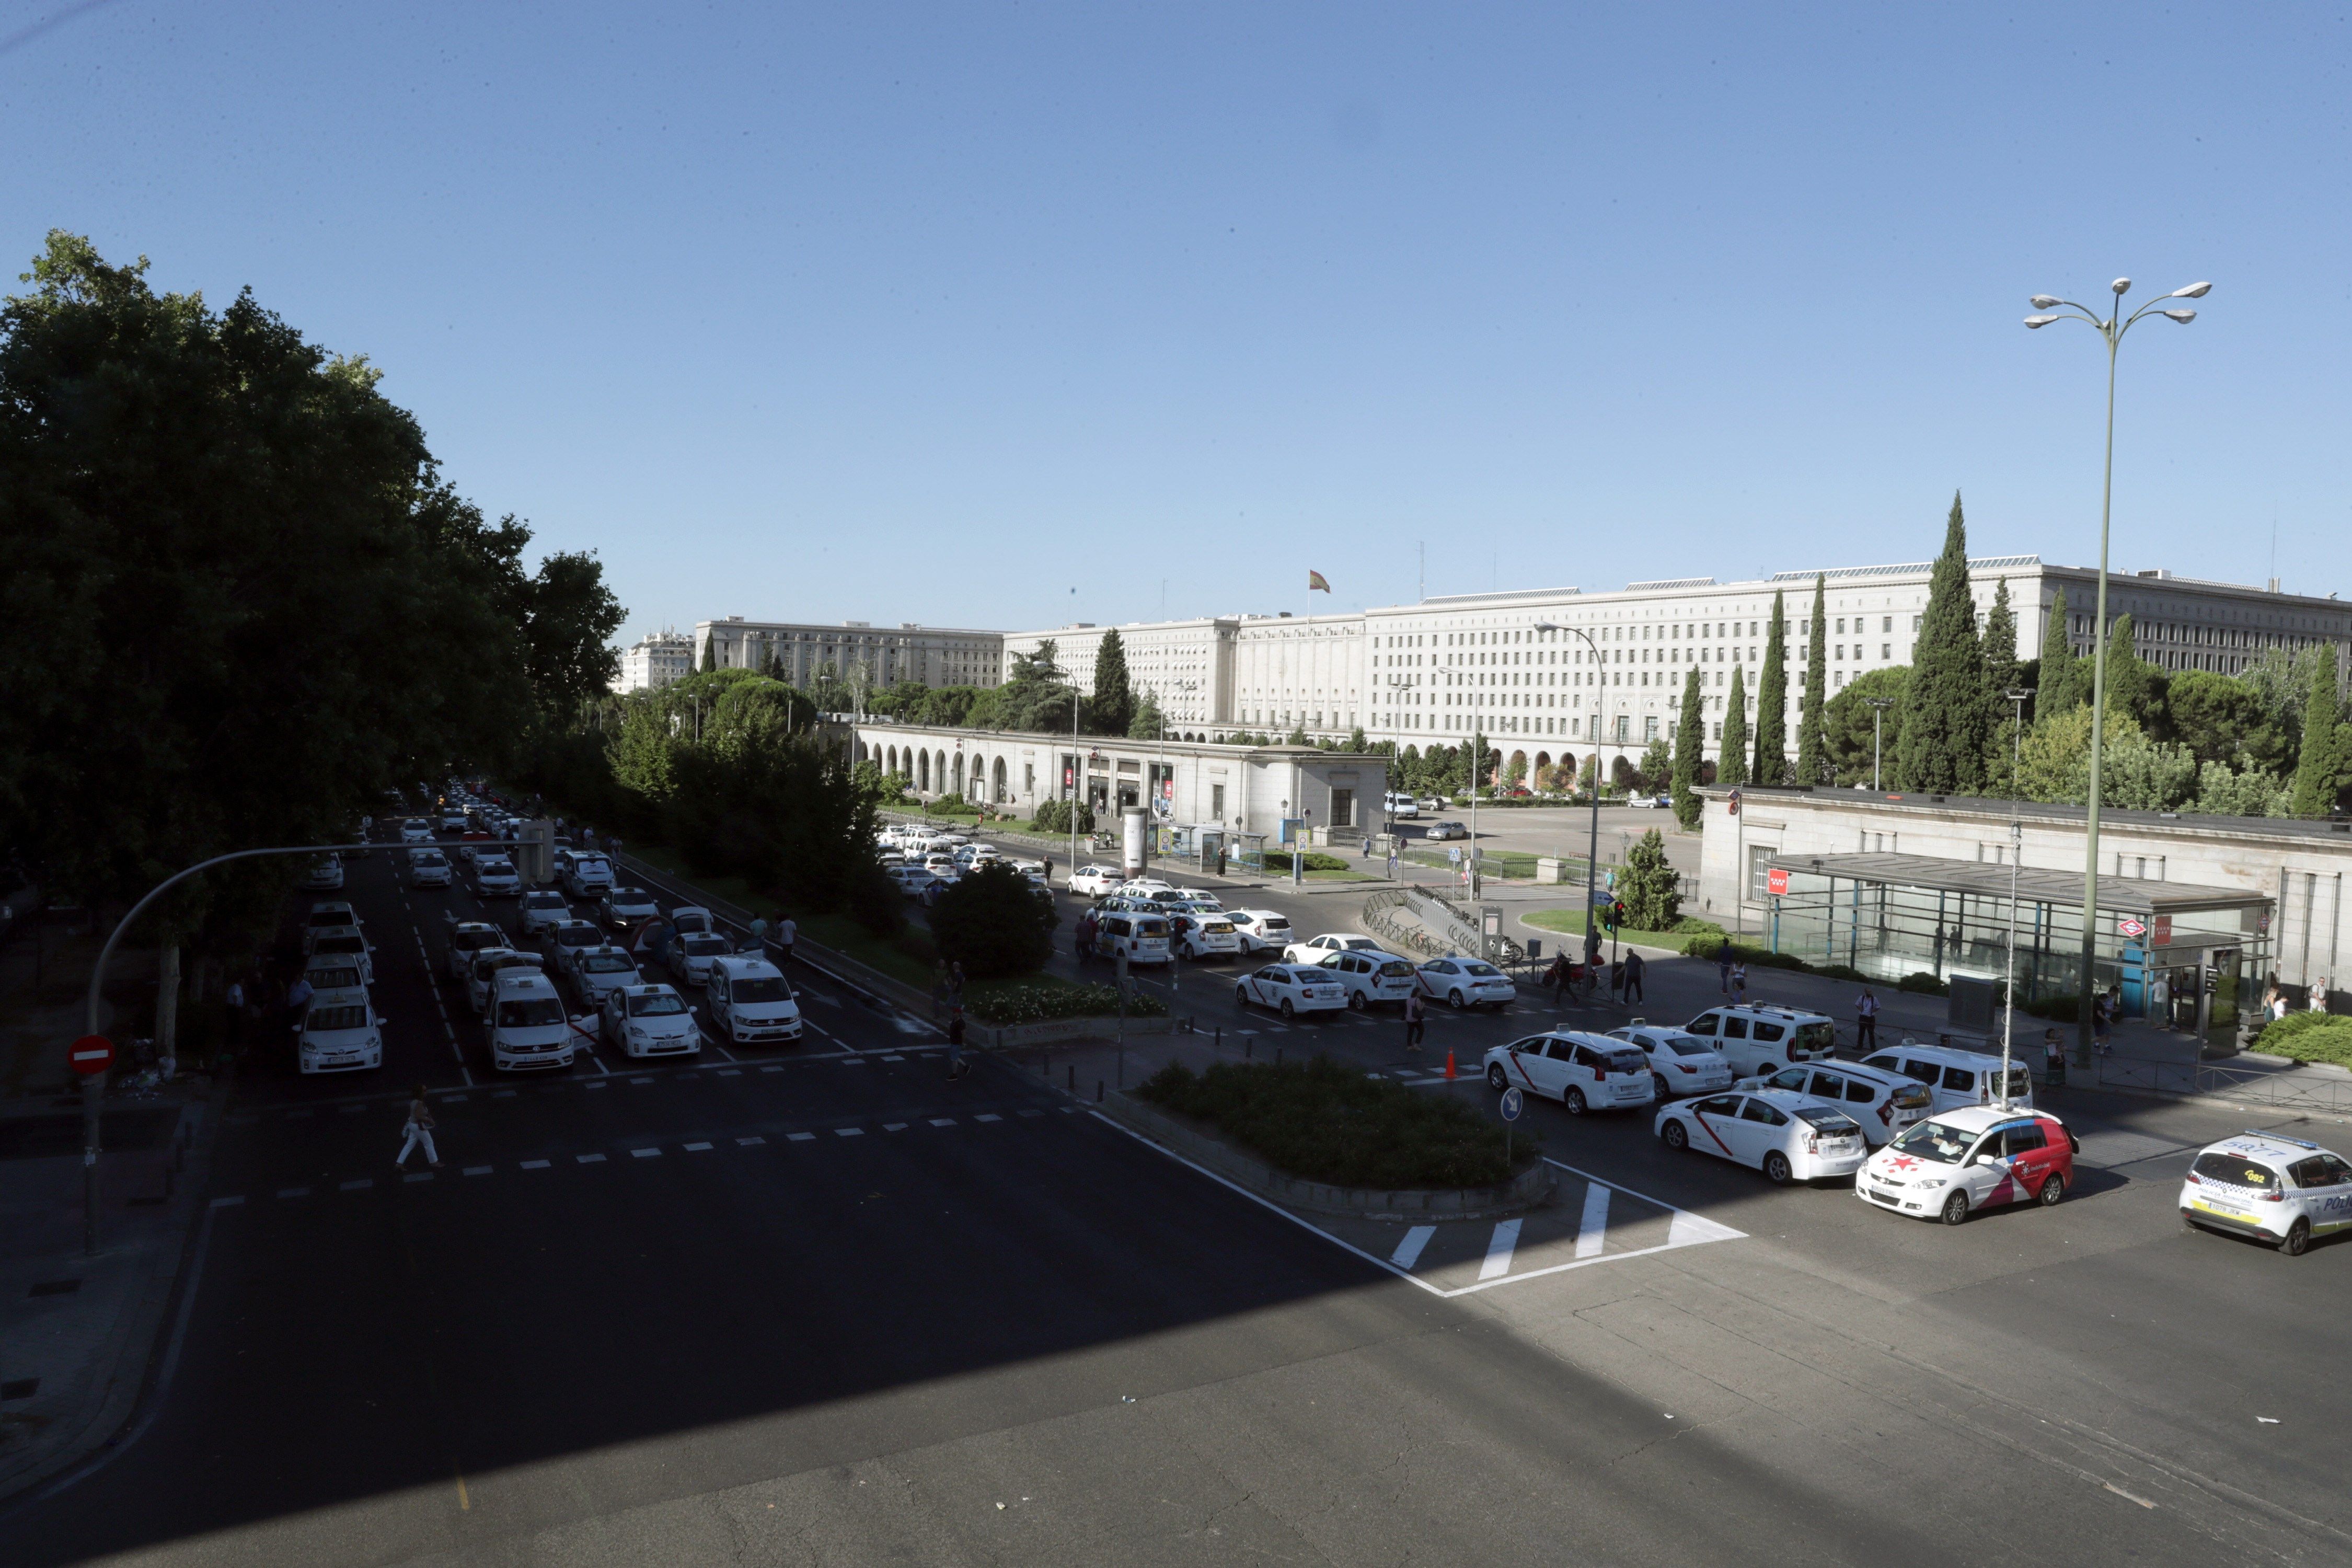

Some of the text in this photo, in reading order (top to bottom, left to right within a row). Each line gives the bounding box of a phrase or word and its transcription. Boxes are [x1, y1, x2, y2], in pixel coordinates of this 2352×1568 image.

[2222, 1142, 2287, 1156] 5077
[2247, 1173, 2265, 1183] 092
[2222, 1194, 2253, 1204] MUNICIPAL
